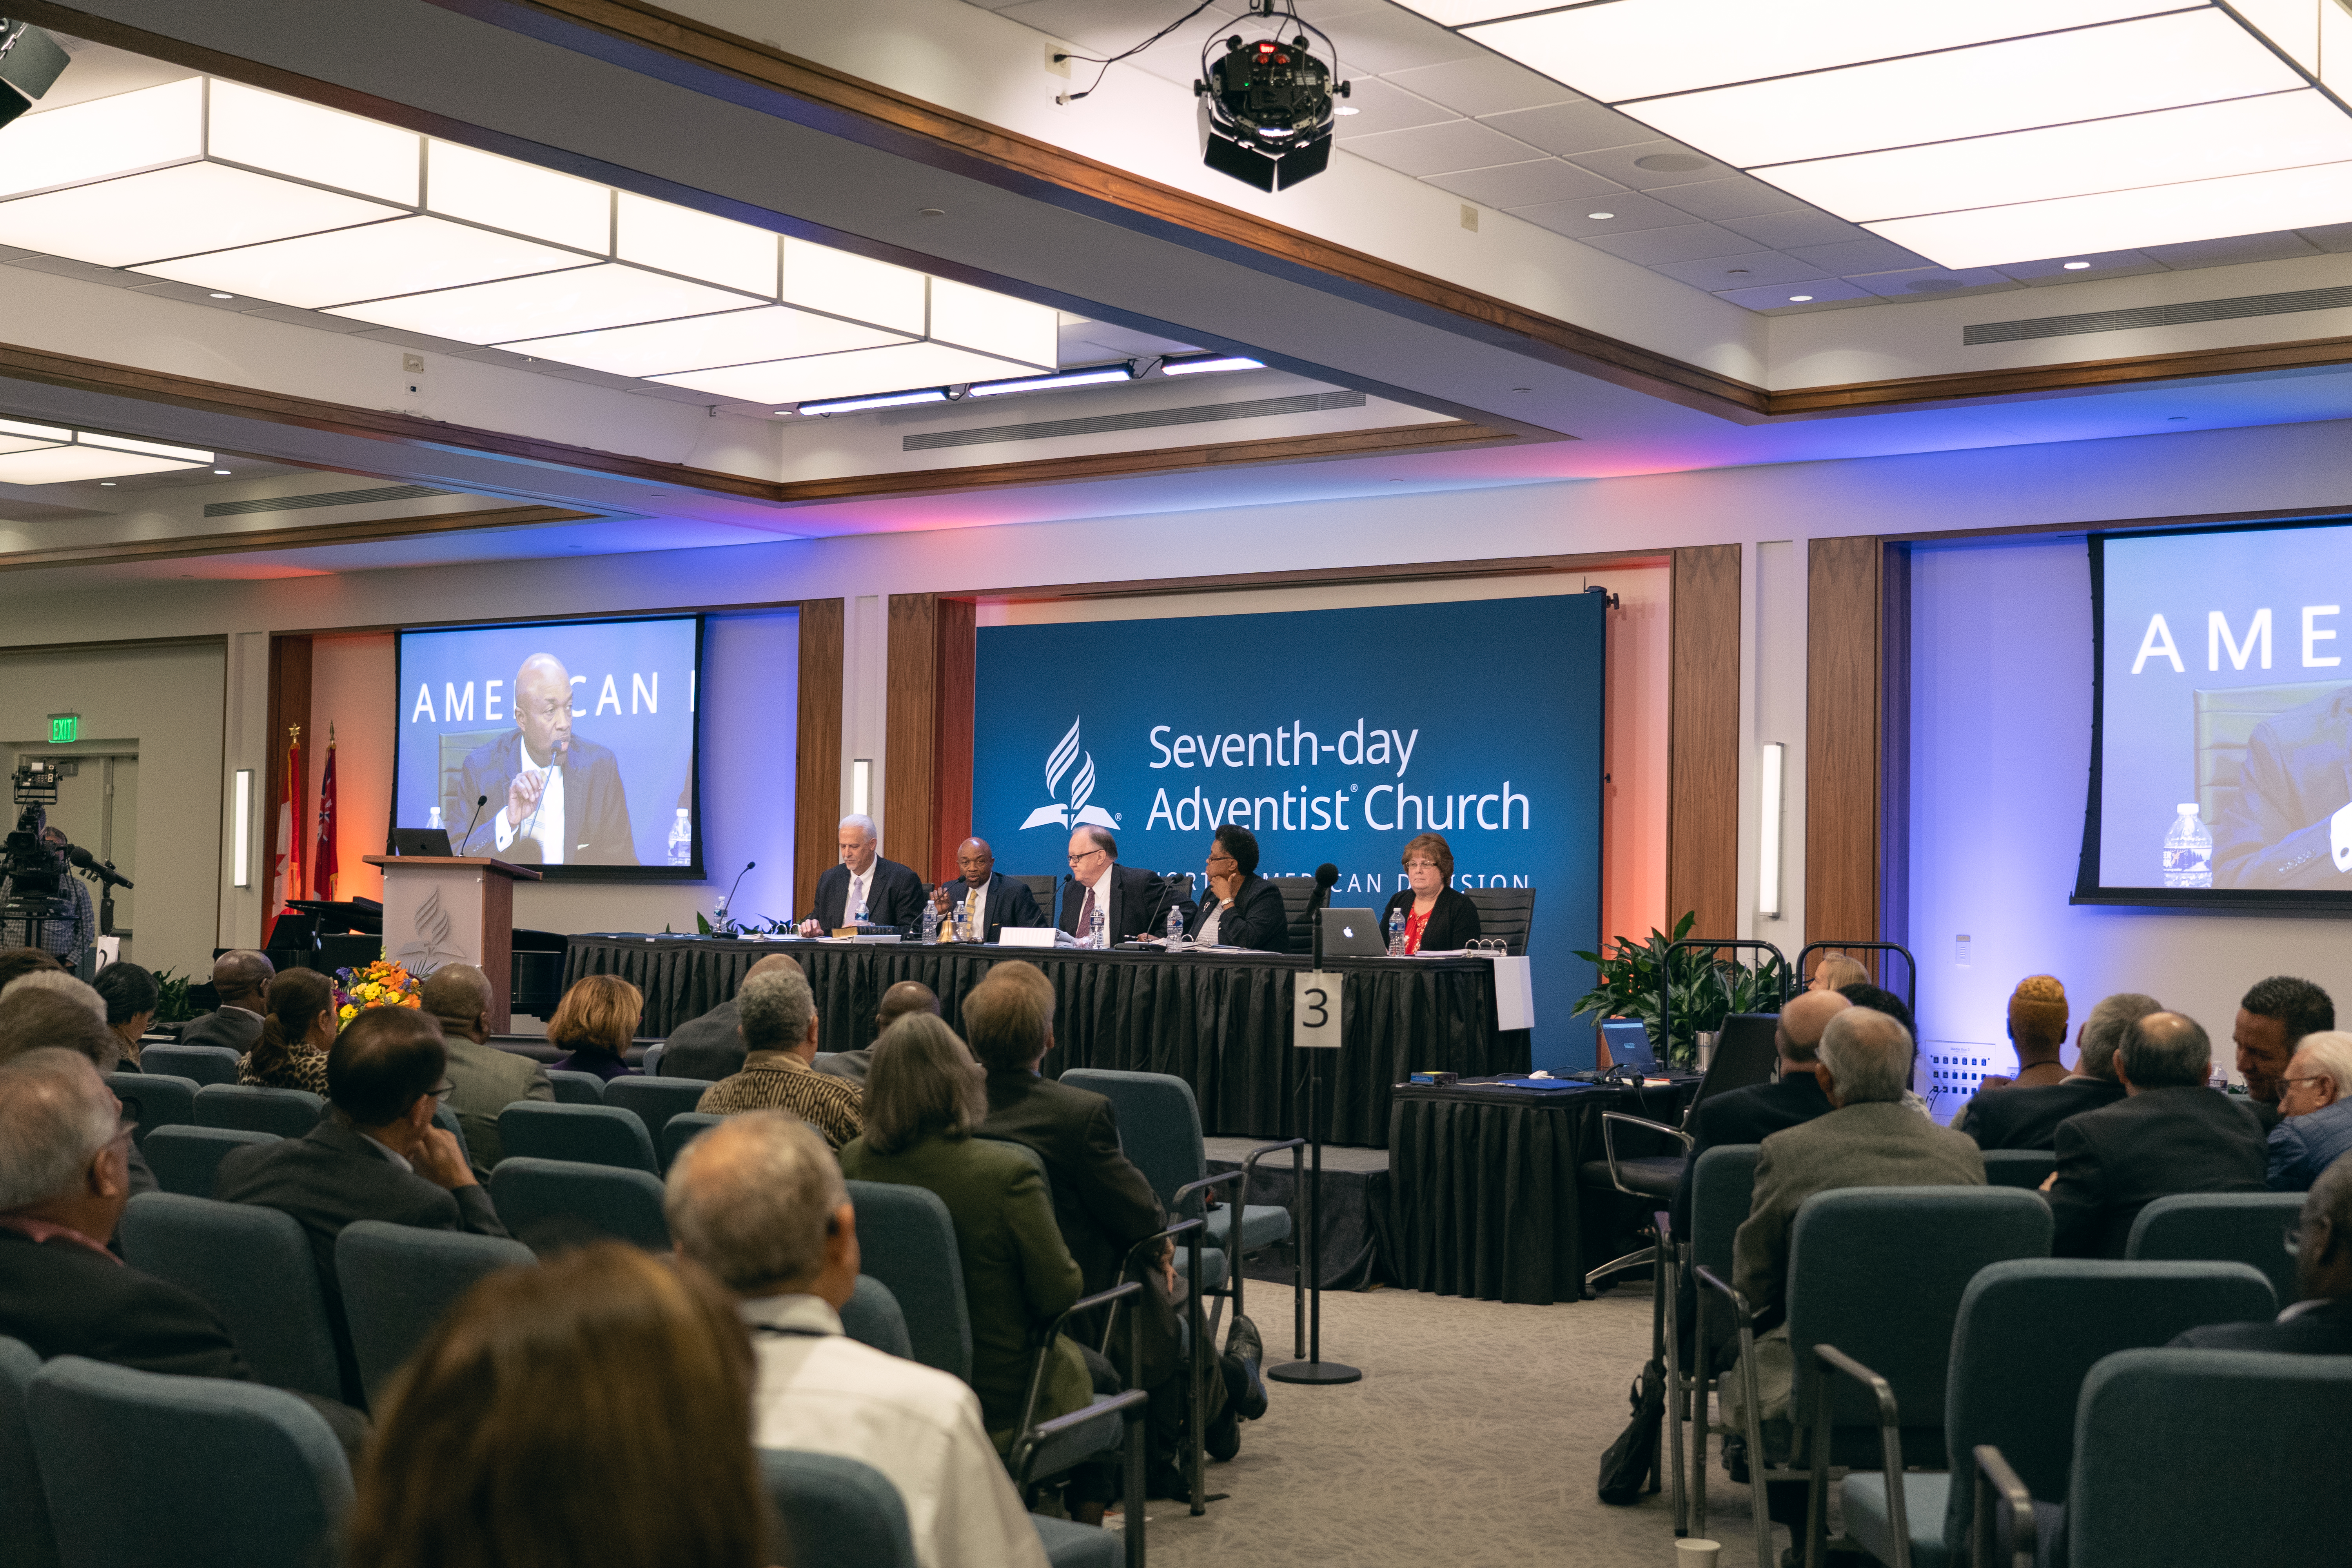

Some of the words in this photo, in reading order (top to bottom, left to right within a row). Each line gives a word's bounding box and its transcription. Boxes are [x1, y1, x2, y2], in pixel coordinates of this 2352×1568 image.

[2131, 605, 2341, 674] AME
[412, 671, 658, 723] AMECAN
[53, 719, 73, 740] EXIT
[1149, 718, 1418, 777] Seventh-day
[1365, 780, 1529, 830] Church
[1303, 988, 1328, 1028] 3
